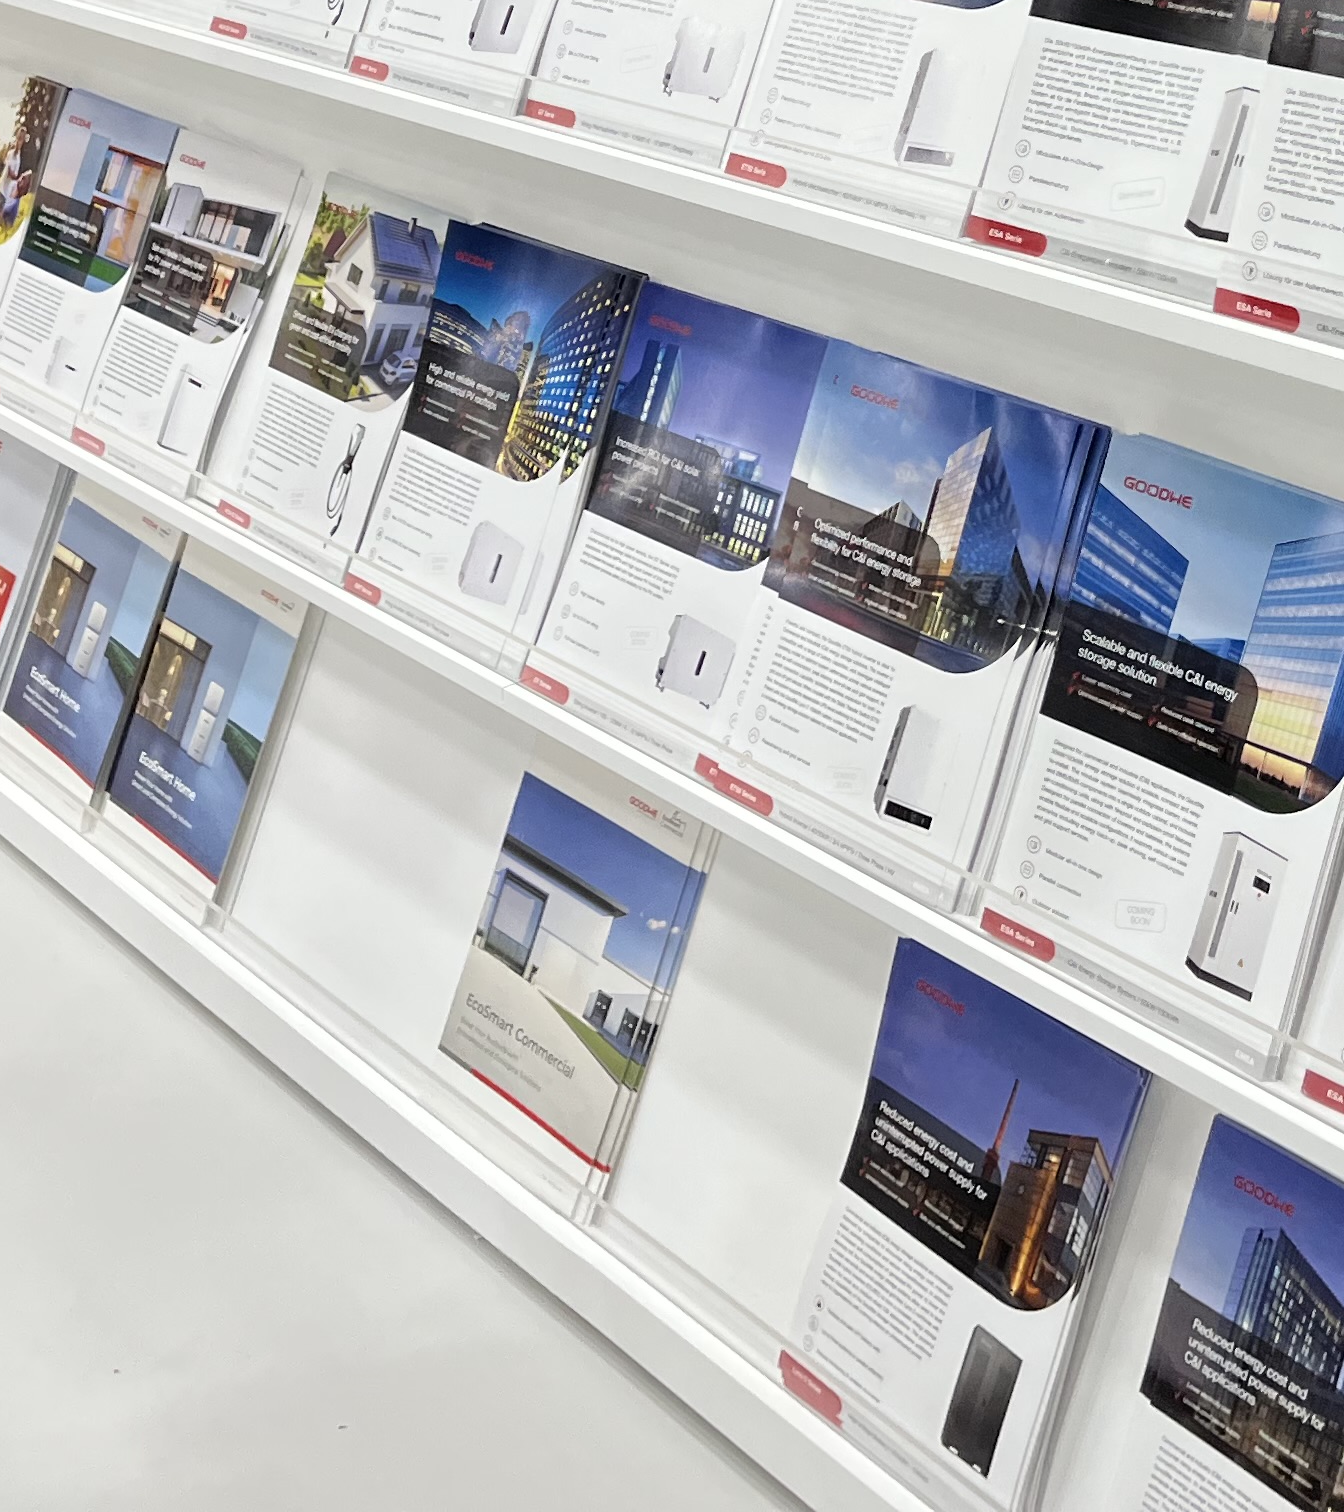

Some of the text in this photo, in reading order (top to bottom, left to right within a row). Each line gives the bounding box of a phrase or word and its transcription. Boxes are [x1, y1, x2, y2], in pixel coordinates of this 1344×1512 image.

[851, 384, 899, 409] GOODWE
[1123, 475, 1193, 510] GOODWE
[897, 552, 914, 567] and
[1077, 646, 1158, 688] storage solution
[1082, 628, 1239, 704] Scalable and flexible C&I energy
[58, 688, 82, 714] Home
[172, 775, 198, 802] Home
[466, 992, 515, 1037] EcoSmart
[514, 1027, 576, 1080] Commercial
[870, 1127, 887, 1147] C&I
[879, 1099, 976, 1175] Reduced energy cost and
[923, 1150, 950, 1174] power
[948, 1167, 976, 1195] supply
[974, 1183, 989, 1202] for
[1233, 1174, 1296, 1218] GOODWE
[1184, 1350, 1258, 1407] C&I applications
[1192, 1316, 1310, 1401] Reduced energy cost and
[1187, 1336, 1327, 1433] uninterrupted power supply for
